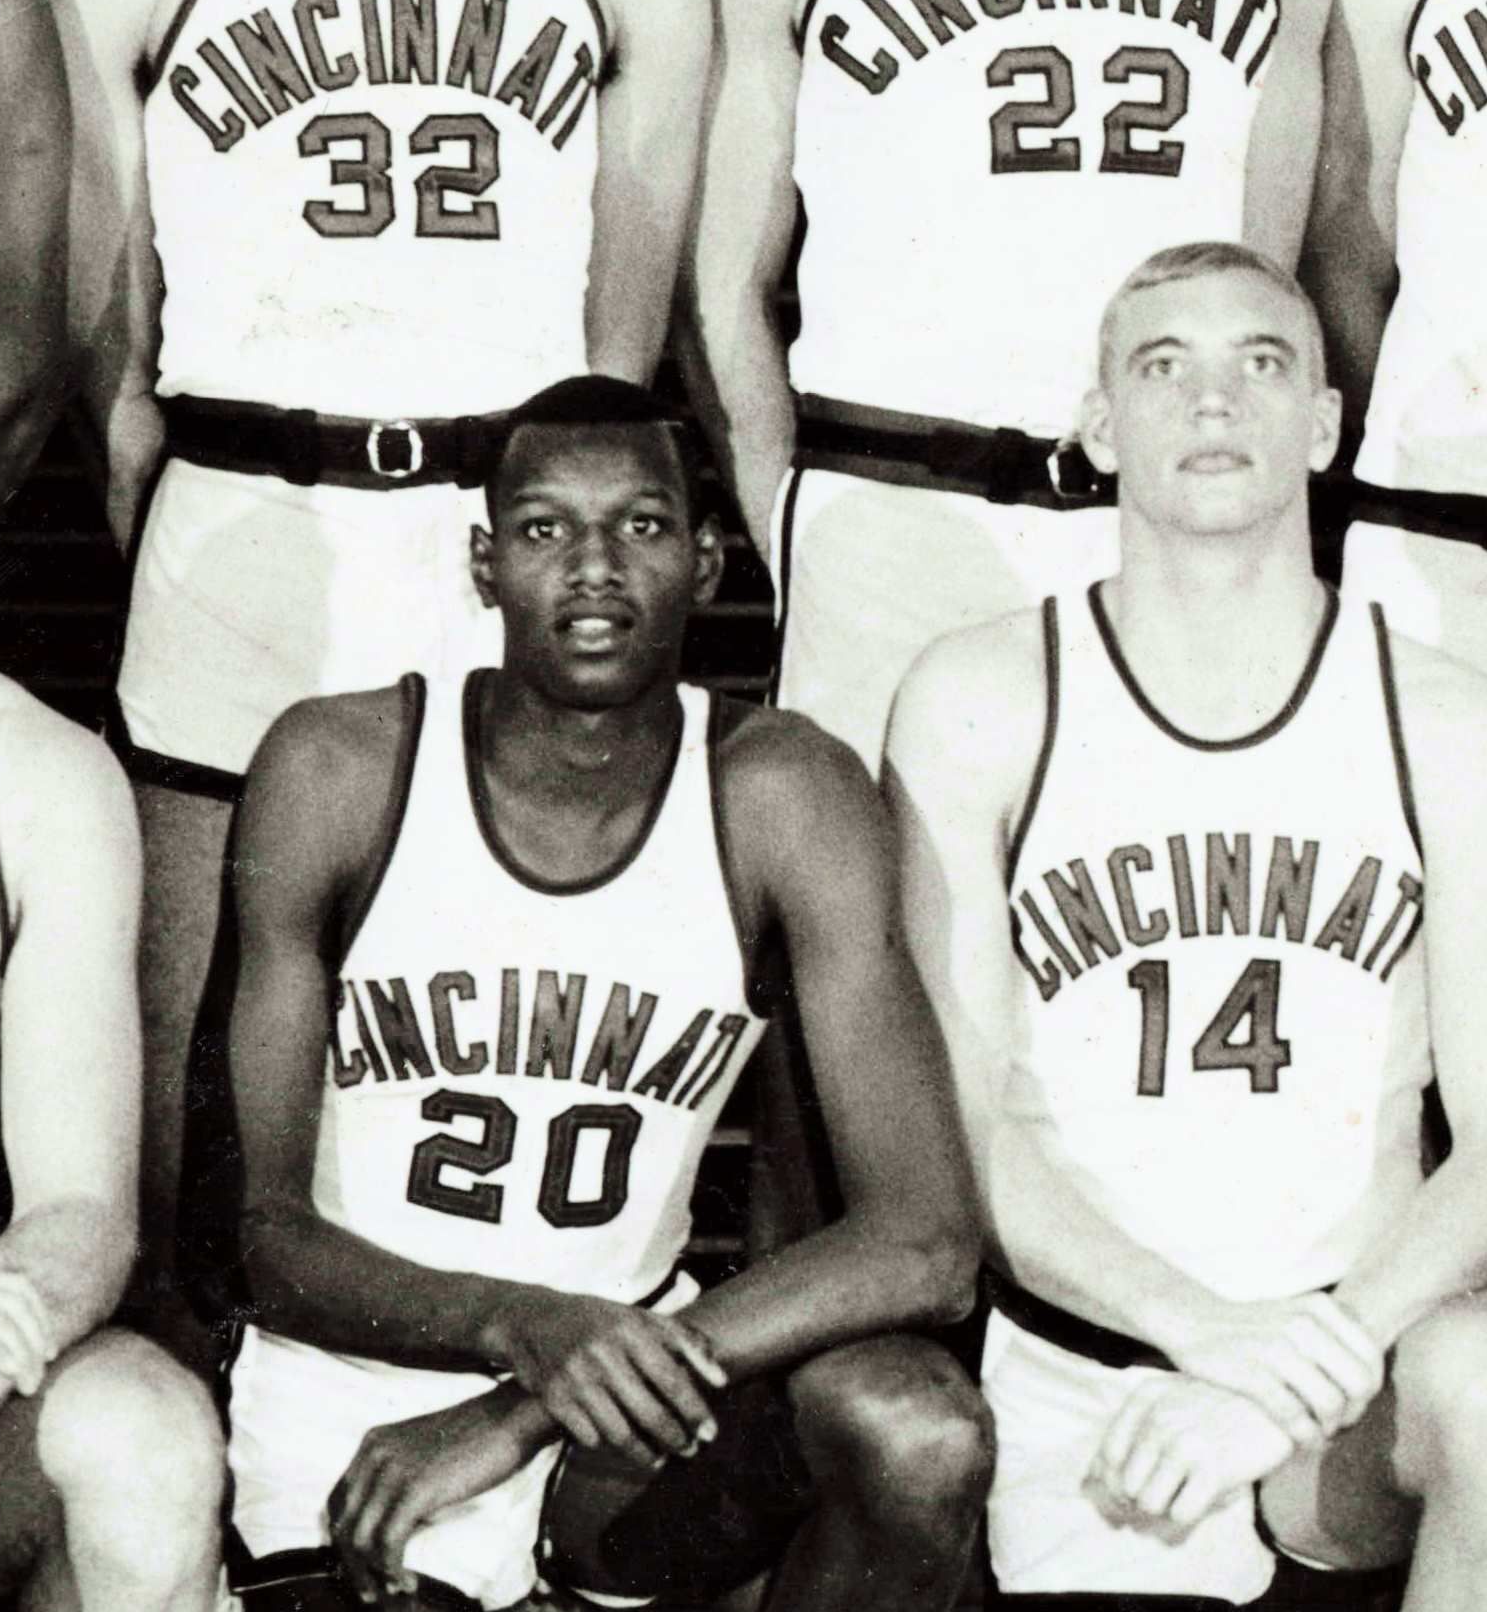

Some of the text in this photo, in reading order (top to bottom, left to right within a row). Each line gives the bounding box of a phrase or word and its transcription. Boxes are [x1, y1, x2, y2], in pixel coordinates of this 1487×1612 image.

[298, 112, 500, 239] 32
[986, 45, 1189, 177] 22
[1128, 959, 1291, 1097] 14
[407, 1089, 643, 1229] 20
